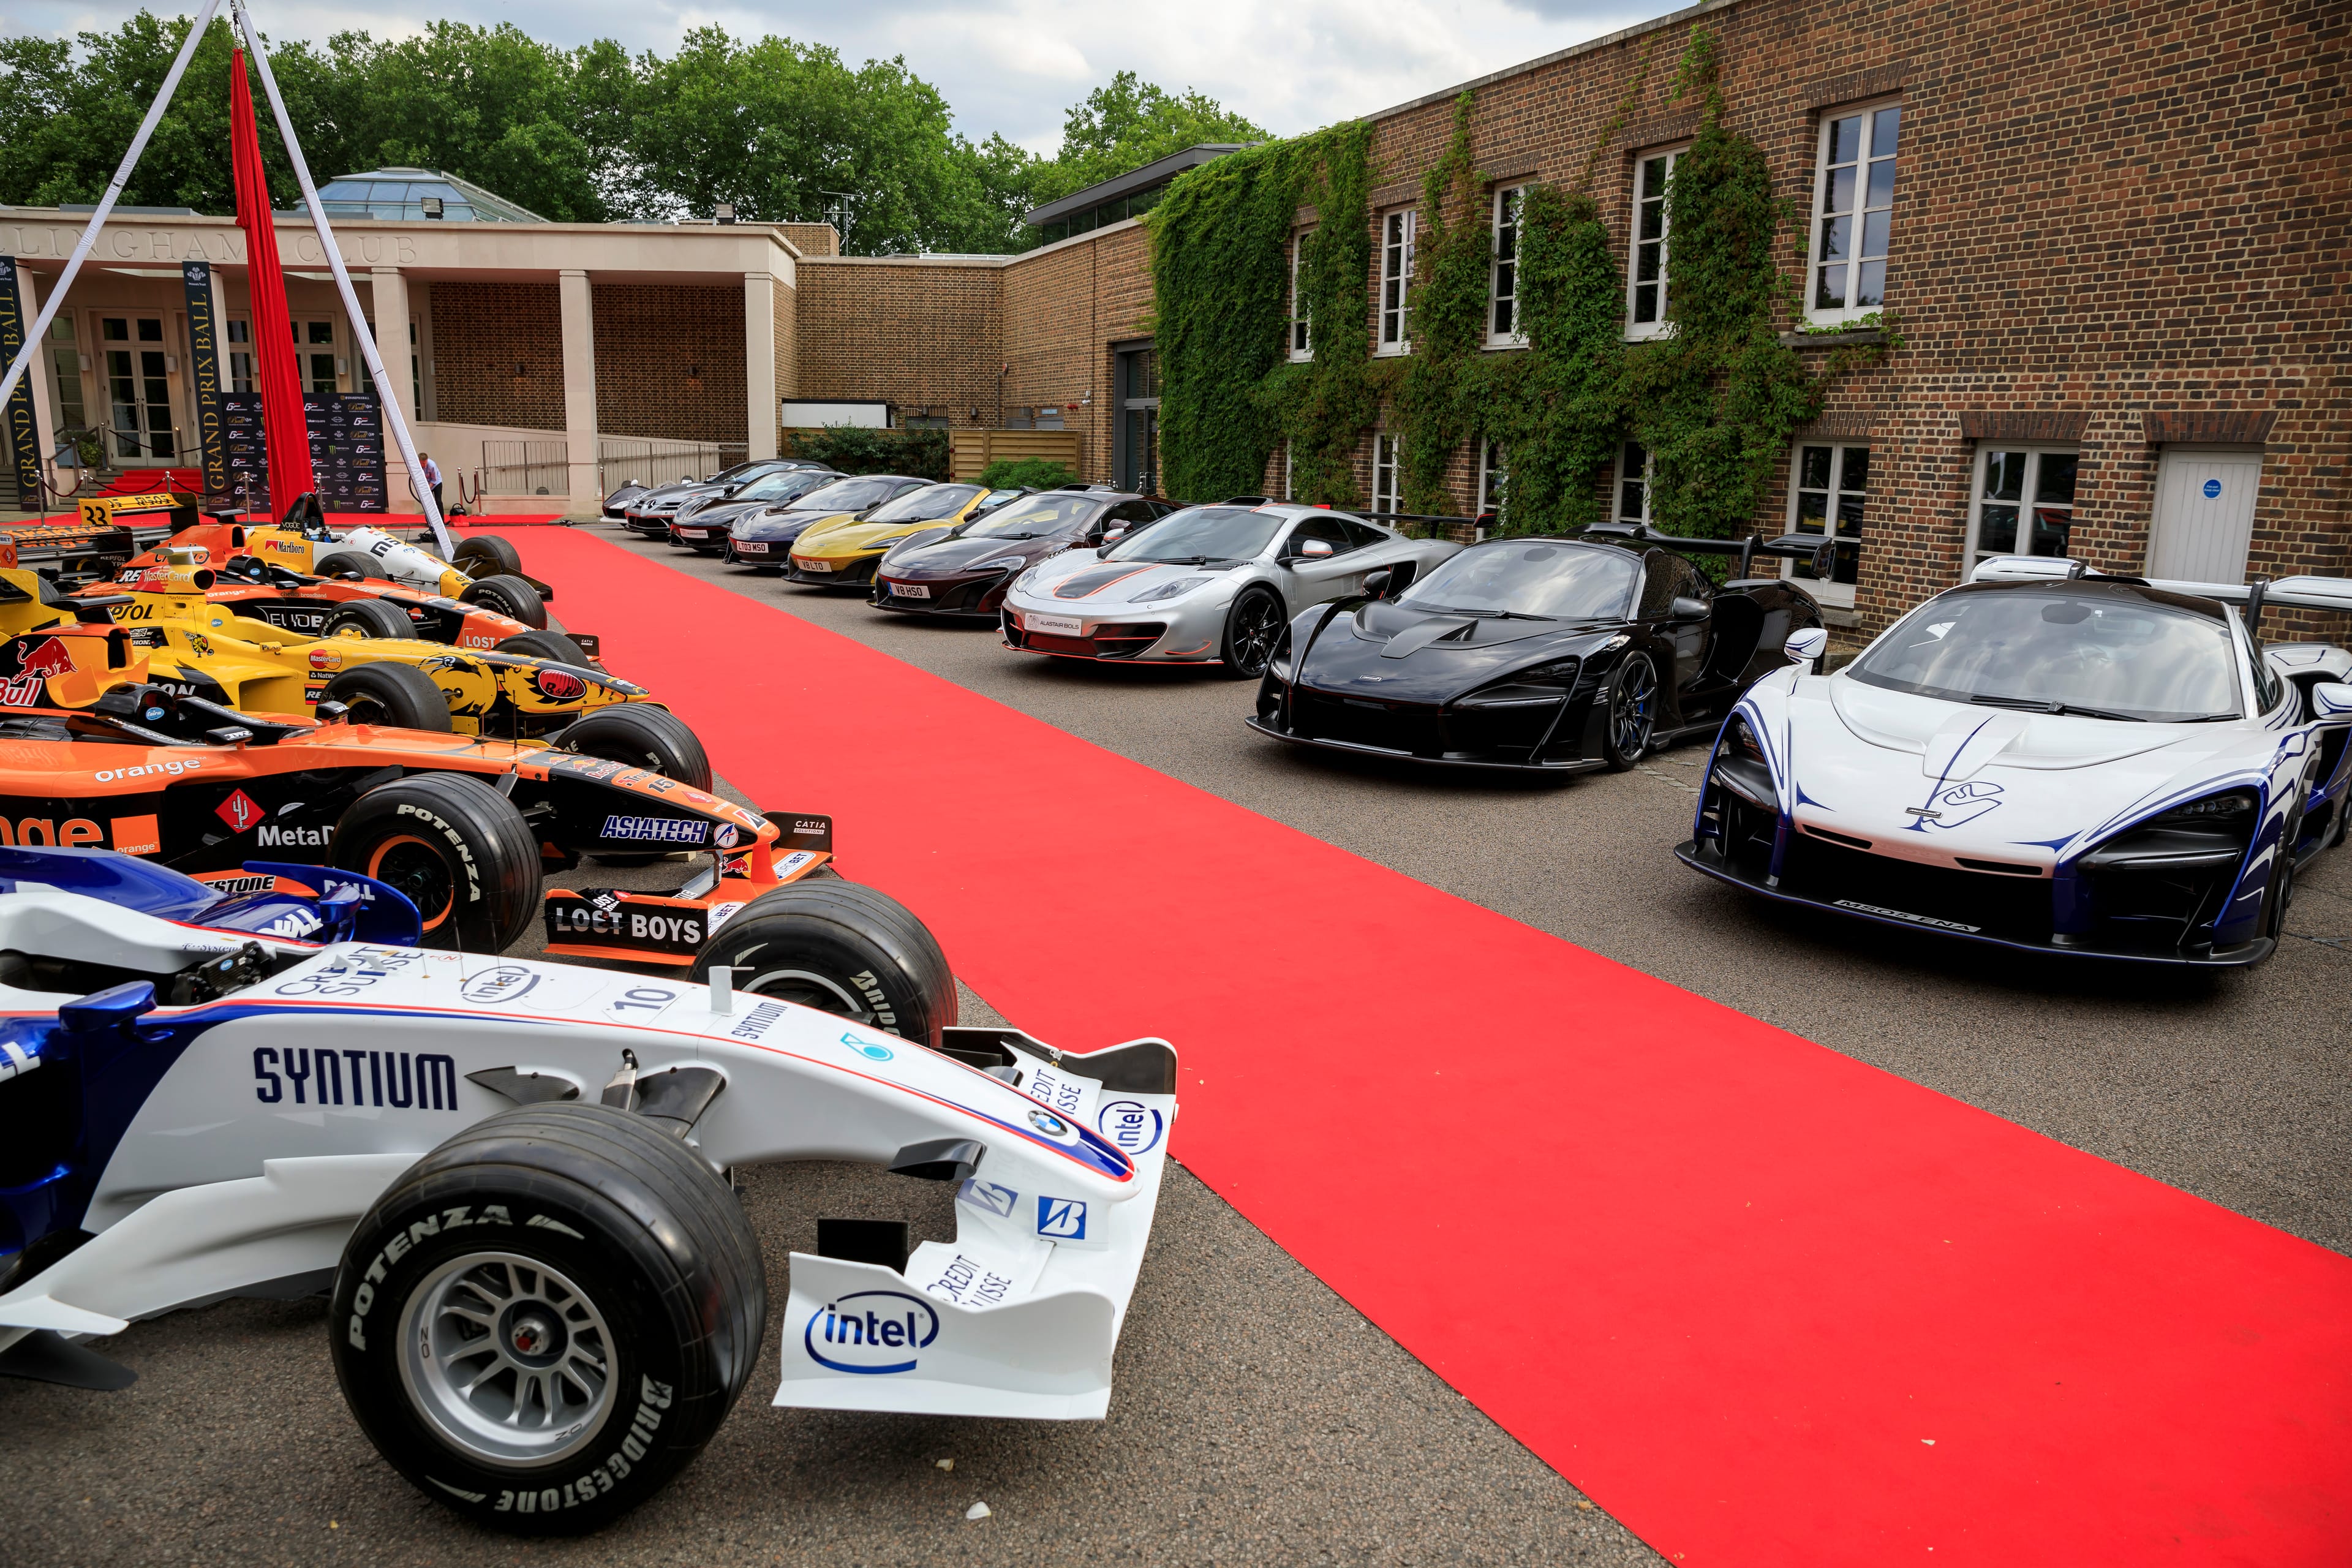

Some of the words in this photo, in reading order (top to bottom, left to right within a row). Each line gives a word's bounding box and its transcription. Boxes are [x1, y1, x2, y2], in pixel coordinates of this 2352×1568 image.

[192, 293, 211, 350] BALL
[198, 355, 217, 406] PRIX
[14, 409, 38, 488] GRAND
[203, 412, 225, 490] GRAND
[85, 506, 108, 526] 33
[277, 540, 305, 554] Marlboro
[738, 542, 752, 551] LT03
[143, 570, 192, 582] MasterCard
[802, 560, 809, 569] V8
[810, 562, 823, 570] LTO
[207, 589, 246, 598] orange
[895, 585, 905, 595] V8
[907, 586, 923, 597] HSO
[108, 604, 154, 620] PSOL
[466, 635, 496, 649] LOST
[0, 677, 43, 707] Bull
[647, 778, 677, 794] 15
[600, 815, 709, 844] ASIATECH
[795, 820, 826, 829] CATIA
[397, 804, 483, 902] POTENZA
[323, 879, 375, 901] DLL
[556, 907, 623, 935] LOST
[631, 913, 701, 944] BOYS
[1917, 917, 1971, 932] ENA
[613, 987, 677, 1011] 10
[731, 1002, 788, 1040] SYNTIUM
[253, 1047, 458, 1111] SYNTIUM
[349, 1205, 514, 1352] POTENZA
[824, 1303, 917, 1348] intel
[494, 1373, 673, 1514] BRIDGESTONE
